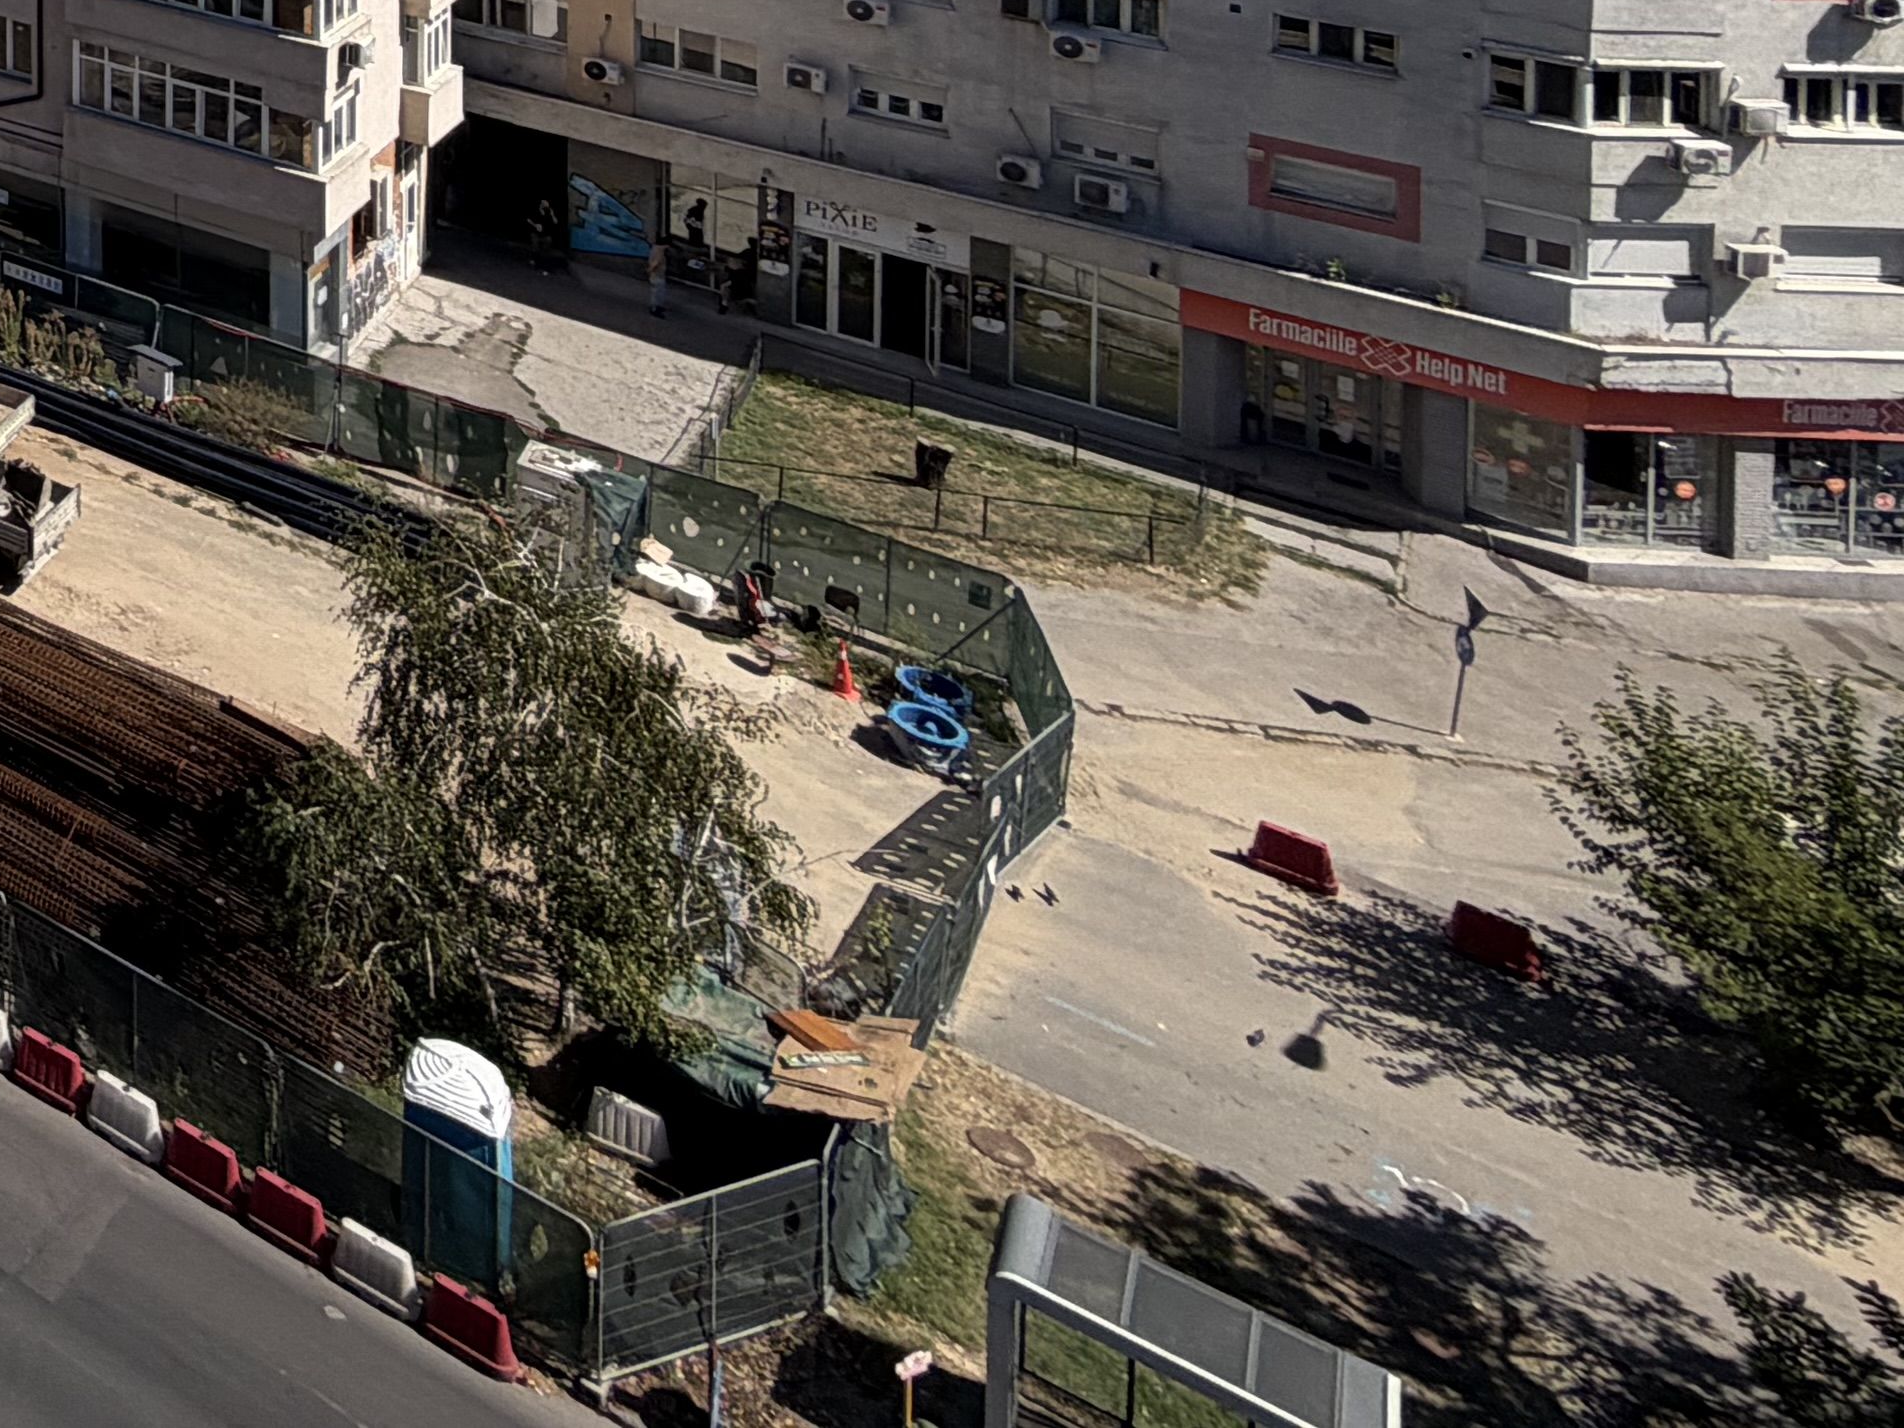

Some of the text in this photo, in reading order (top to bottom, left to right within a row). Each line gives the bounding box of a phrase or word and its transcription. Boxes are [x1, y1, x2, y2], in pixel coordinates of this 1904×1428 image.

[1249, 308, 1507, 394] Farmaciile Help Net
[1782, 400, 1879, 427] Farmaciile
